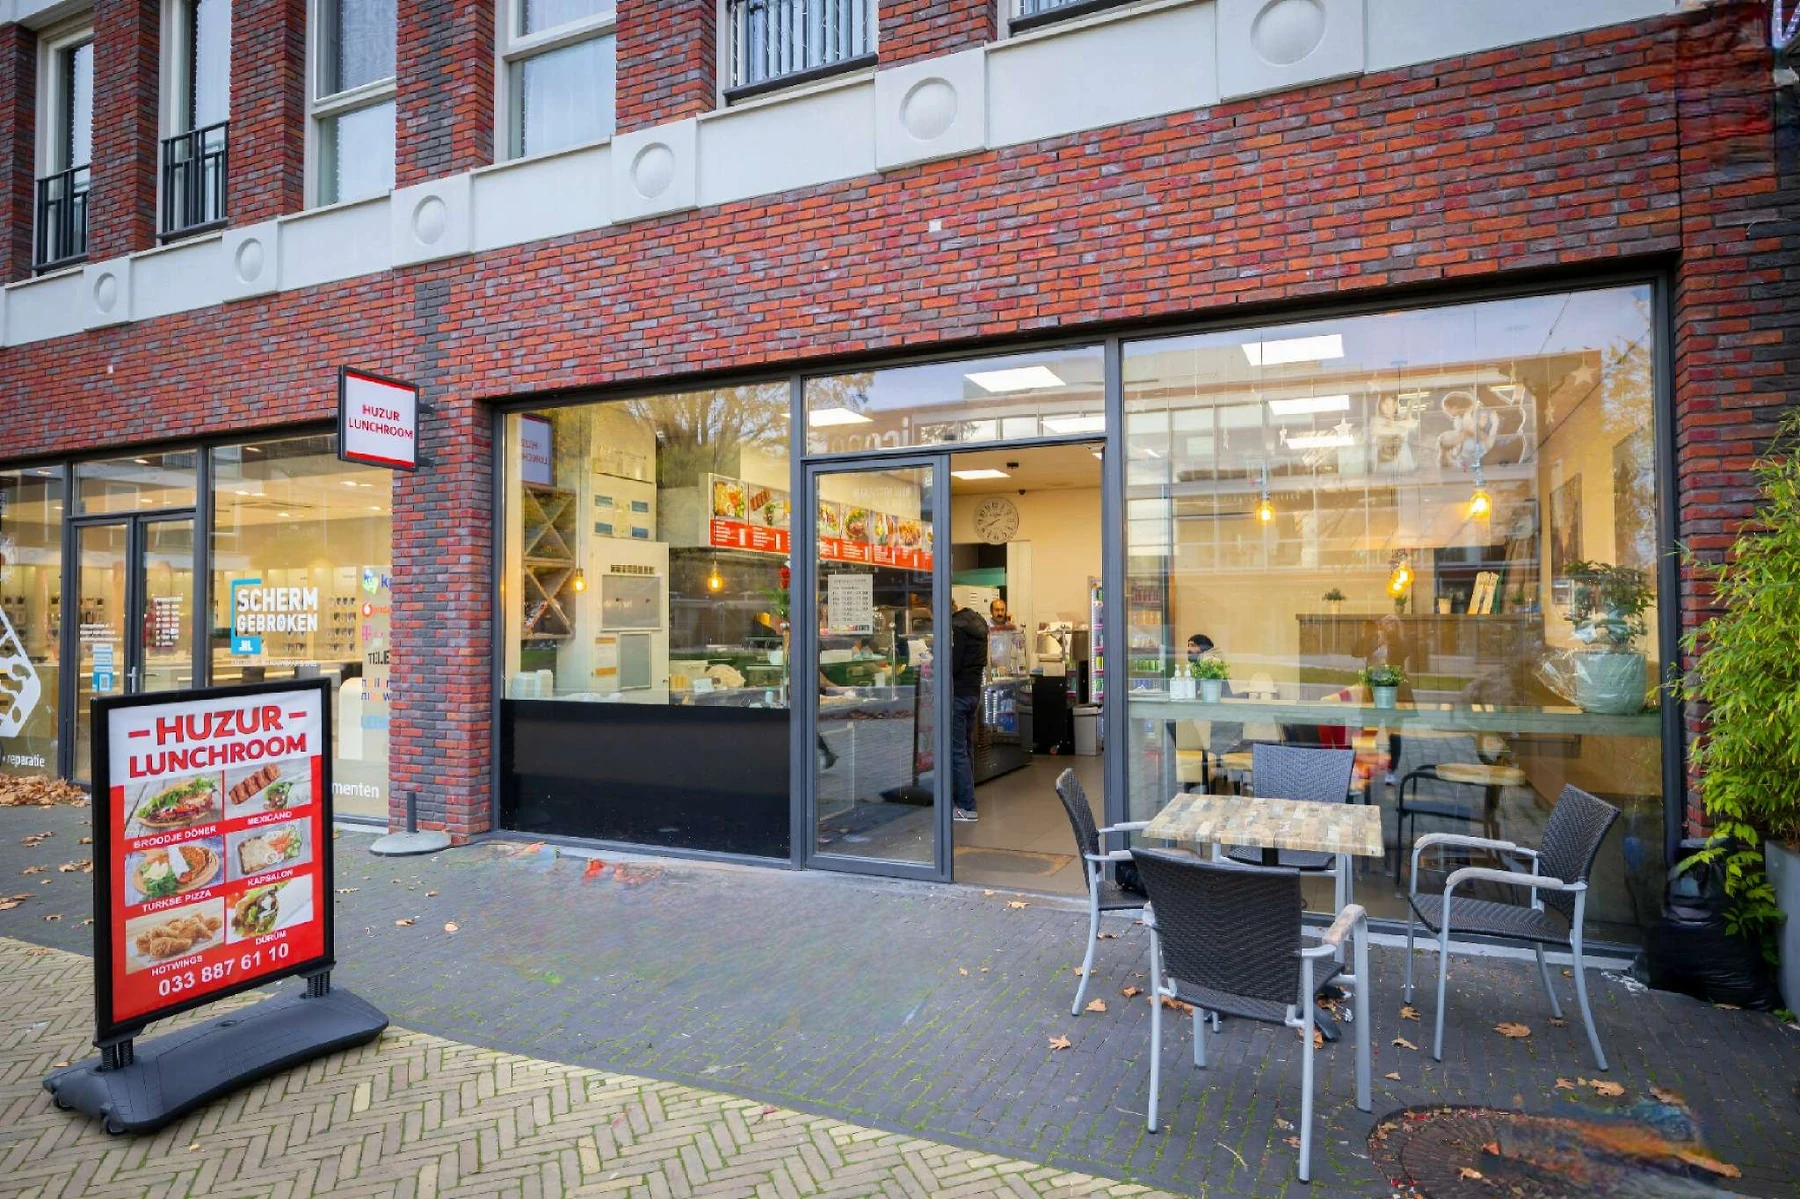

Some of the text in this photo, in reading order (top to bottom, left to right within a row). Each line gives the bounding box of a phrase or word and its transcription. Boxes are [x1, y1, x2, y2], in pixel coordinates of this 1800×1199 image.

[362, 404, 400, 421] HUZUR
[348, 417, 414, 439] LUNCHROOM
[237, 587, 318, 612] SCHERM
[237, 613, 318, 632] GEBROKEN
[156, 705, 283, 745] HUZUR
[7, 753, 46, 767] reparatie
[129, 733, 307, 778] LUNCHROOM
[247, 811, 293, 825] MEXICANO
[133, 831, 182, 849] BROODJE
[247, 868, 293, 886] KAPSALON
[142, 889, 212, 913] TURKSE PIZZA
[151, 955, 203, 976] HOTWINGS
[158, 943, 289, 997] 033 887 61 10
